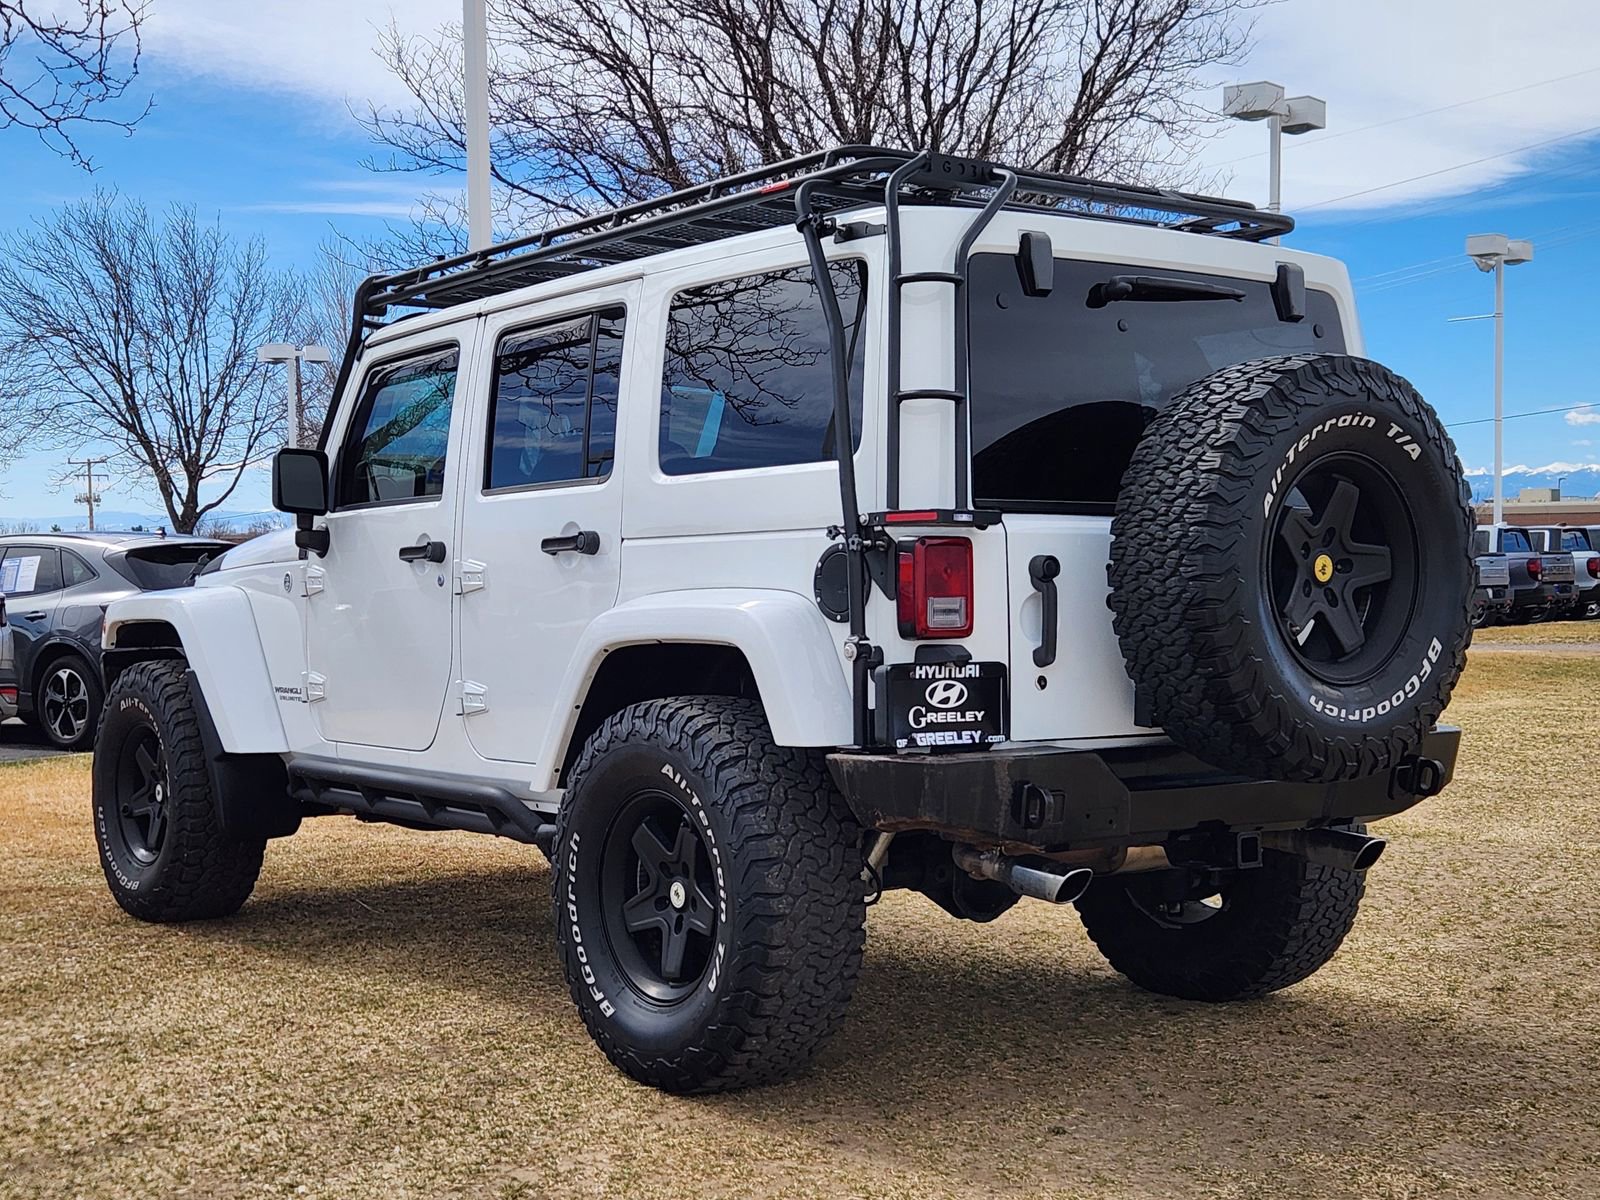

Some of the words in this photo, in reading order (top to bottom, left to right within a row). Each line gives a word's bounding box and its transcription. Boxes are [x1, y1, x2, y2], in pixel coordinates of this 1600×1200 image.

[1263, 412, 1376, 519] All-Terrain
[1386, 422, 1422, 461] T/A
[908, 705, 985, 729] GREELEY
[1309, 636, 1443, 723] BFGoodrich
[914, 730, 982, 746] GREELEY
[566, 831, 617, 1018] BFGoodrich
[661, 763, 727, 923] All-Terrain
[707, 942, 726, 993] T/A
